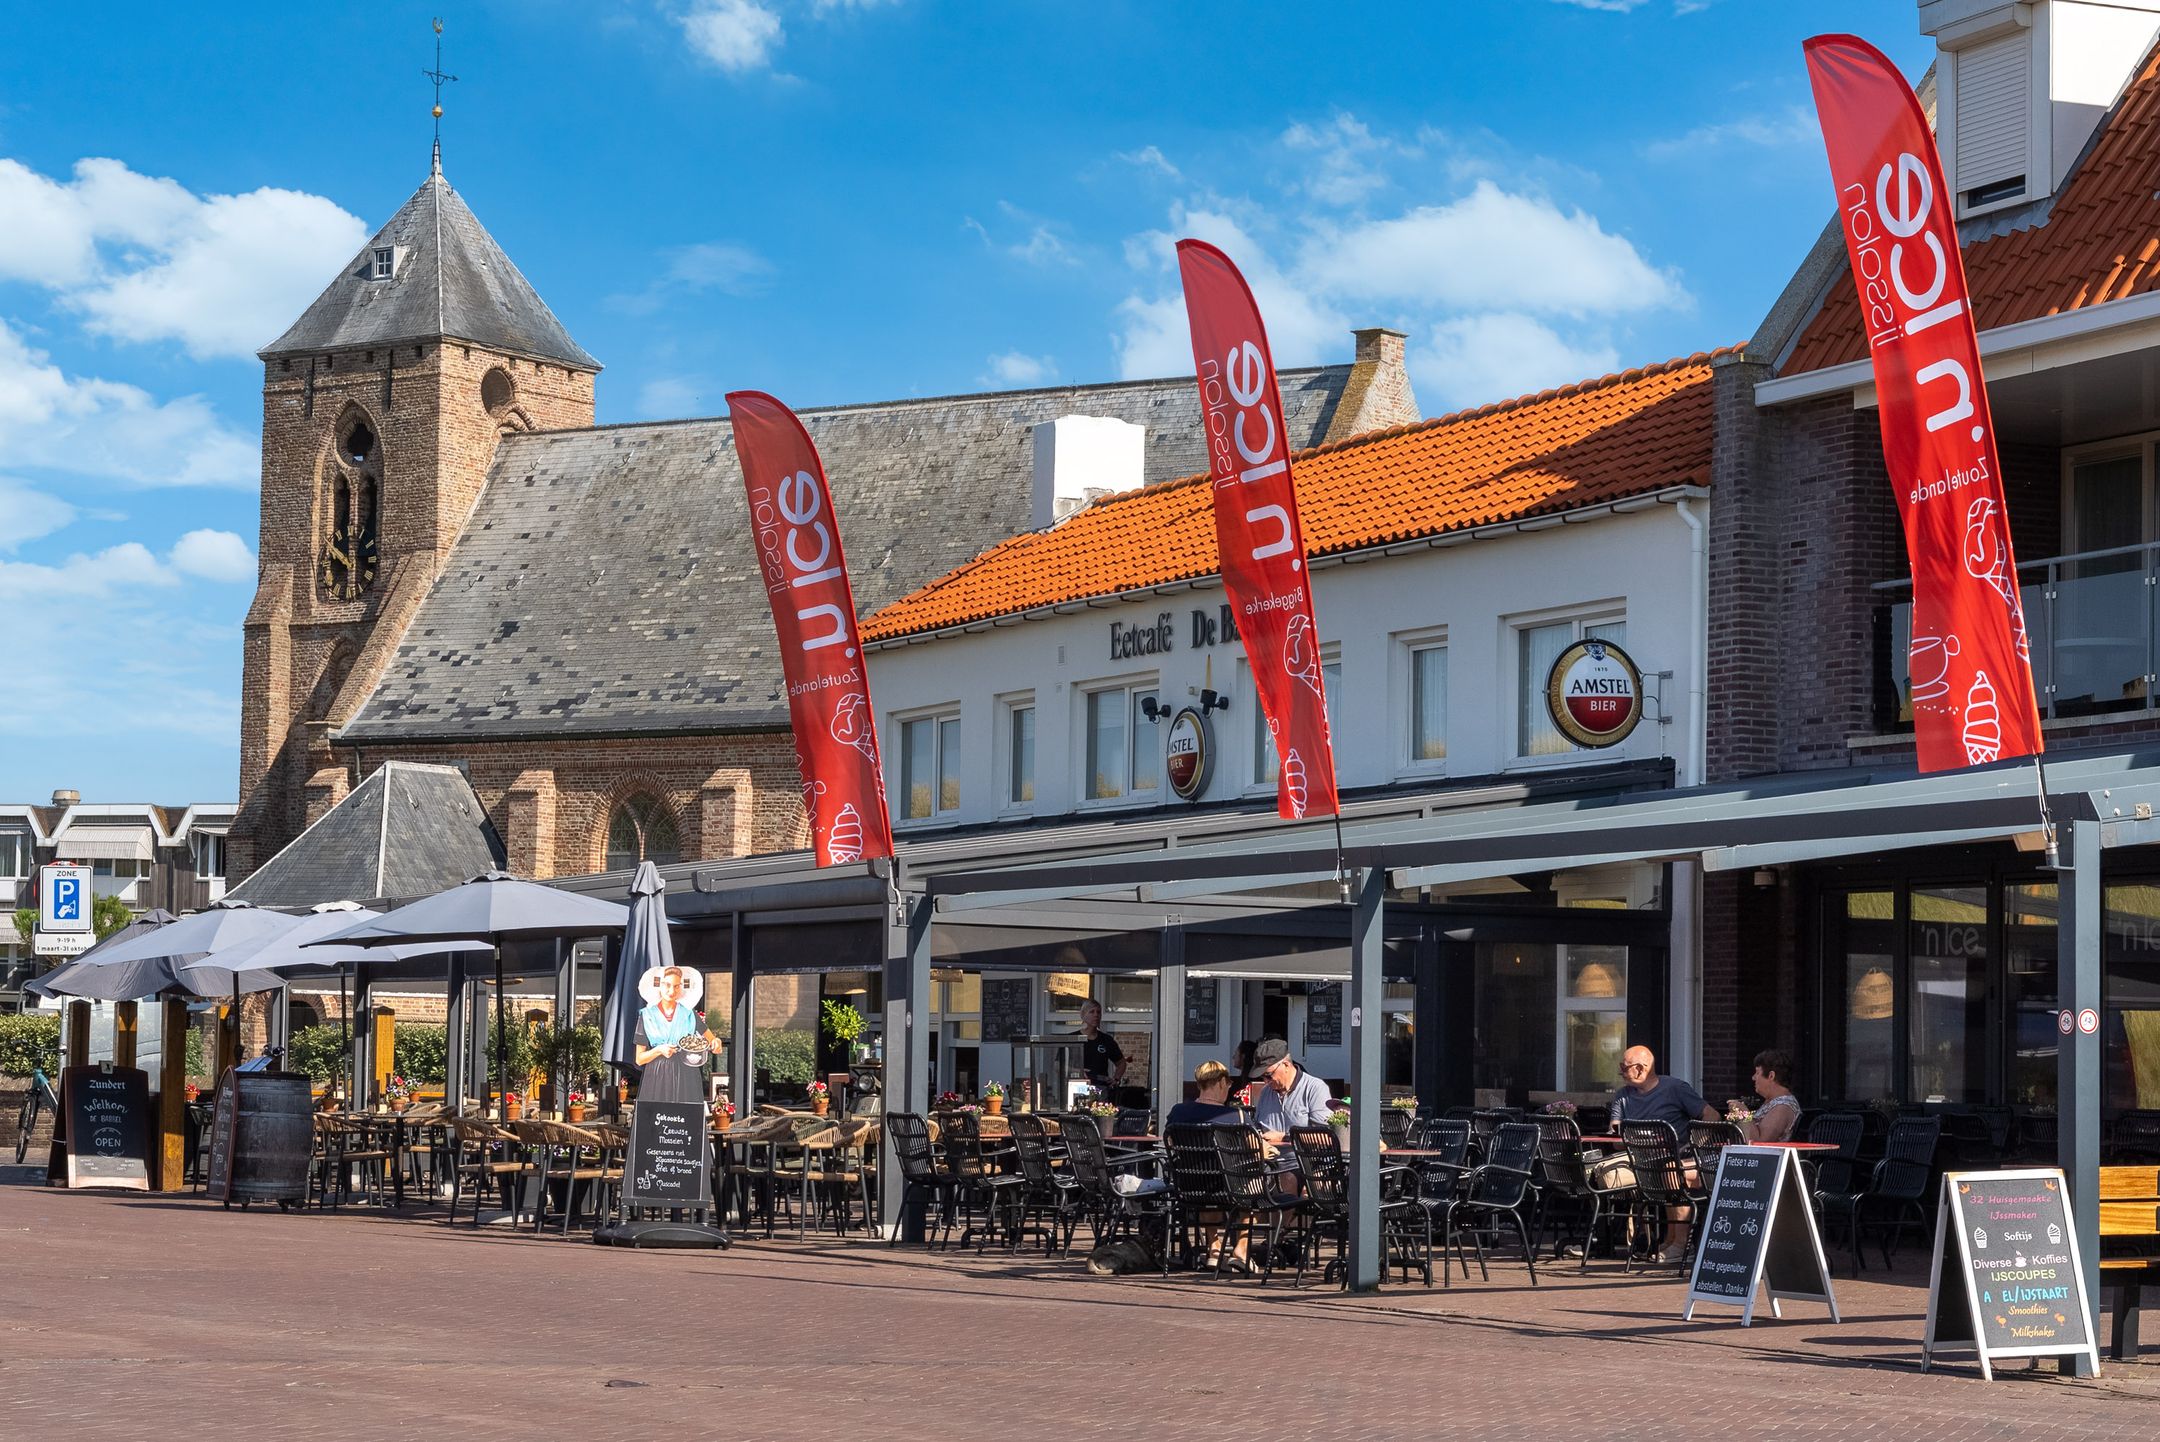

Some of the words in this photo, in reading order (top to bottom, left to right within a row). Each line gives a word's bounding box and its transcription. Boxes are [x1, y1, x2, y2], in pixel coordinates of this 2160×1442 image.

[1109, 612, 1173, 660] Eetcafé
[1190, 609, 1216, 649] De
[1571, 679, 1630, 694] AMSTEL
[1590, 700, 1616, 711] BIER
[59, 881, 75, 903] P
[1944, 922, 1980, 956] Ice
[89, 1080, 126, 1090] Zundert
[84, 1098, 128, 1113] Welkom
[655, 1113, 685, 1125] Gekookte
[95, 1137, 121, 1147] OPEN
[1747, 1159, 1759, 1167] aan
[1721, 1177, 1729, 1187] de
[1730, 1178, 1756, 1189] overkant
[1716, 1198, 1742, 1209] plaatsen.
[1743, 1200, 1759, 1210] Dank
[1970, 1195, 1985, 1204] 32
[2004, 1230, 2033, 1242] Softijs
[1707, 1239, 1735, 1250] Fahrräder
[1702, 1259, 1715, 1270] bitte
[1716, 1262, 1747, 1274] gegenüber
[1973, 1259, 2012, 1269] Diverse
[2032, 1254, 2068, 1265] Koffies
[1991, 1269, 2057, 1282] IJSCOUPES
[1696, 1281, 1723, 1292] abstellen.
[1725, 1283, 1744, 1294] Danke
[2008, 1303, 2048, 1315] Smoothies
[2010, 1325, 2055, 1338] Milkshakes
